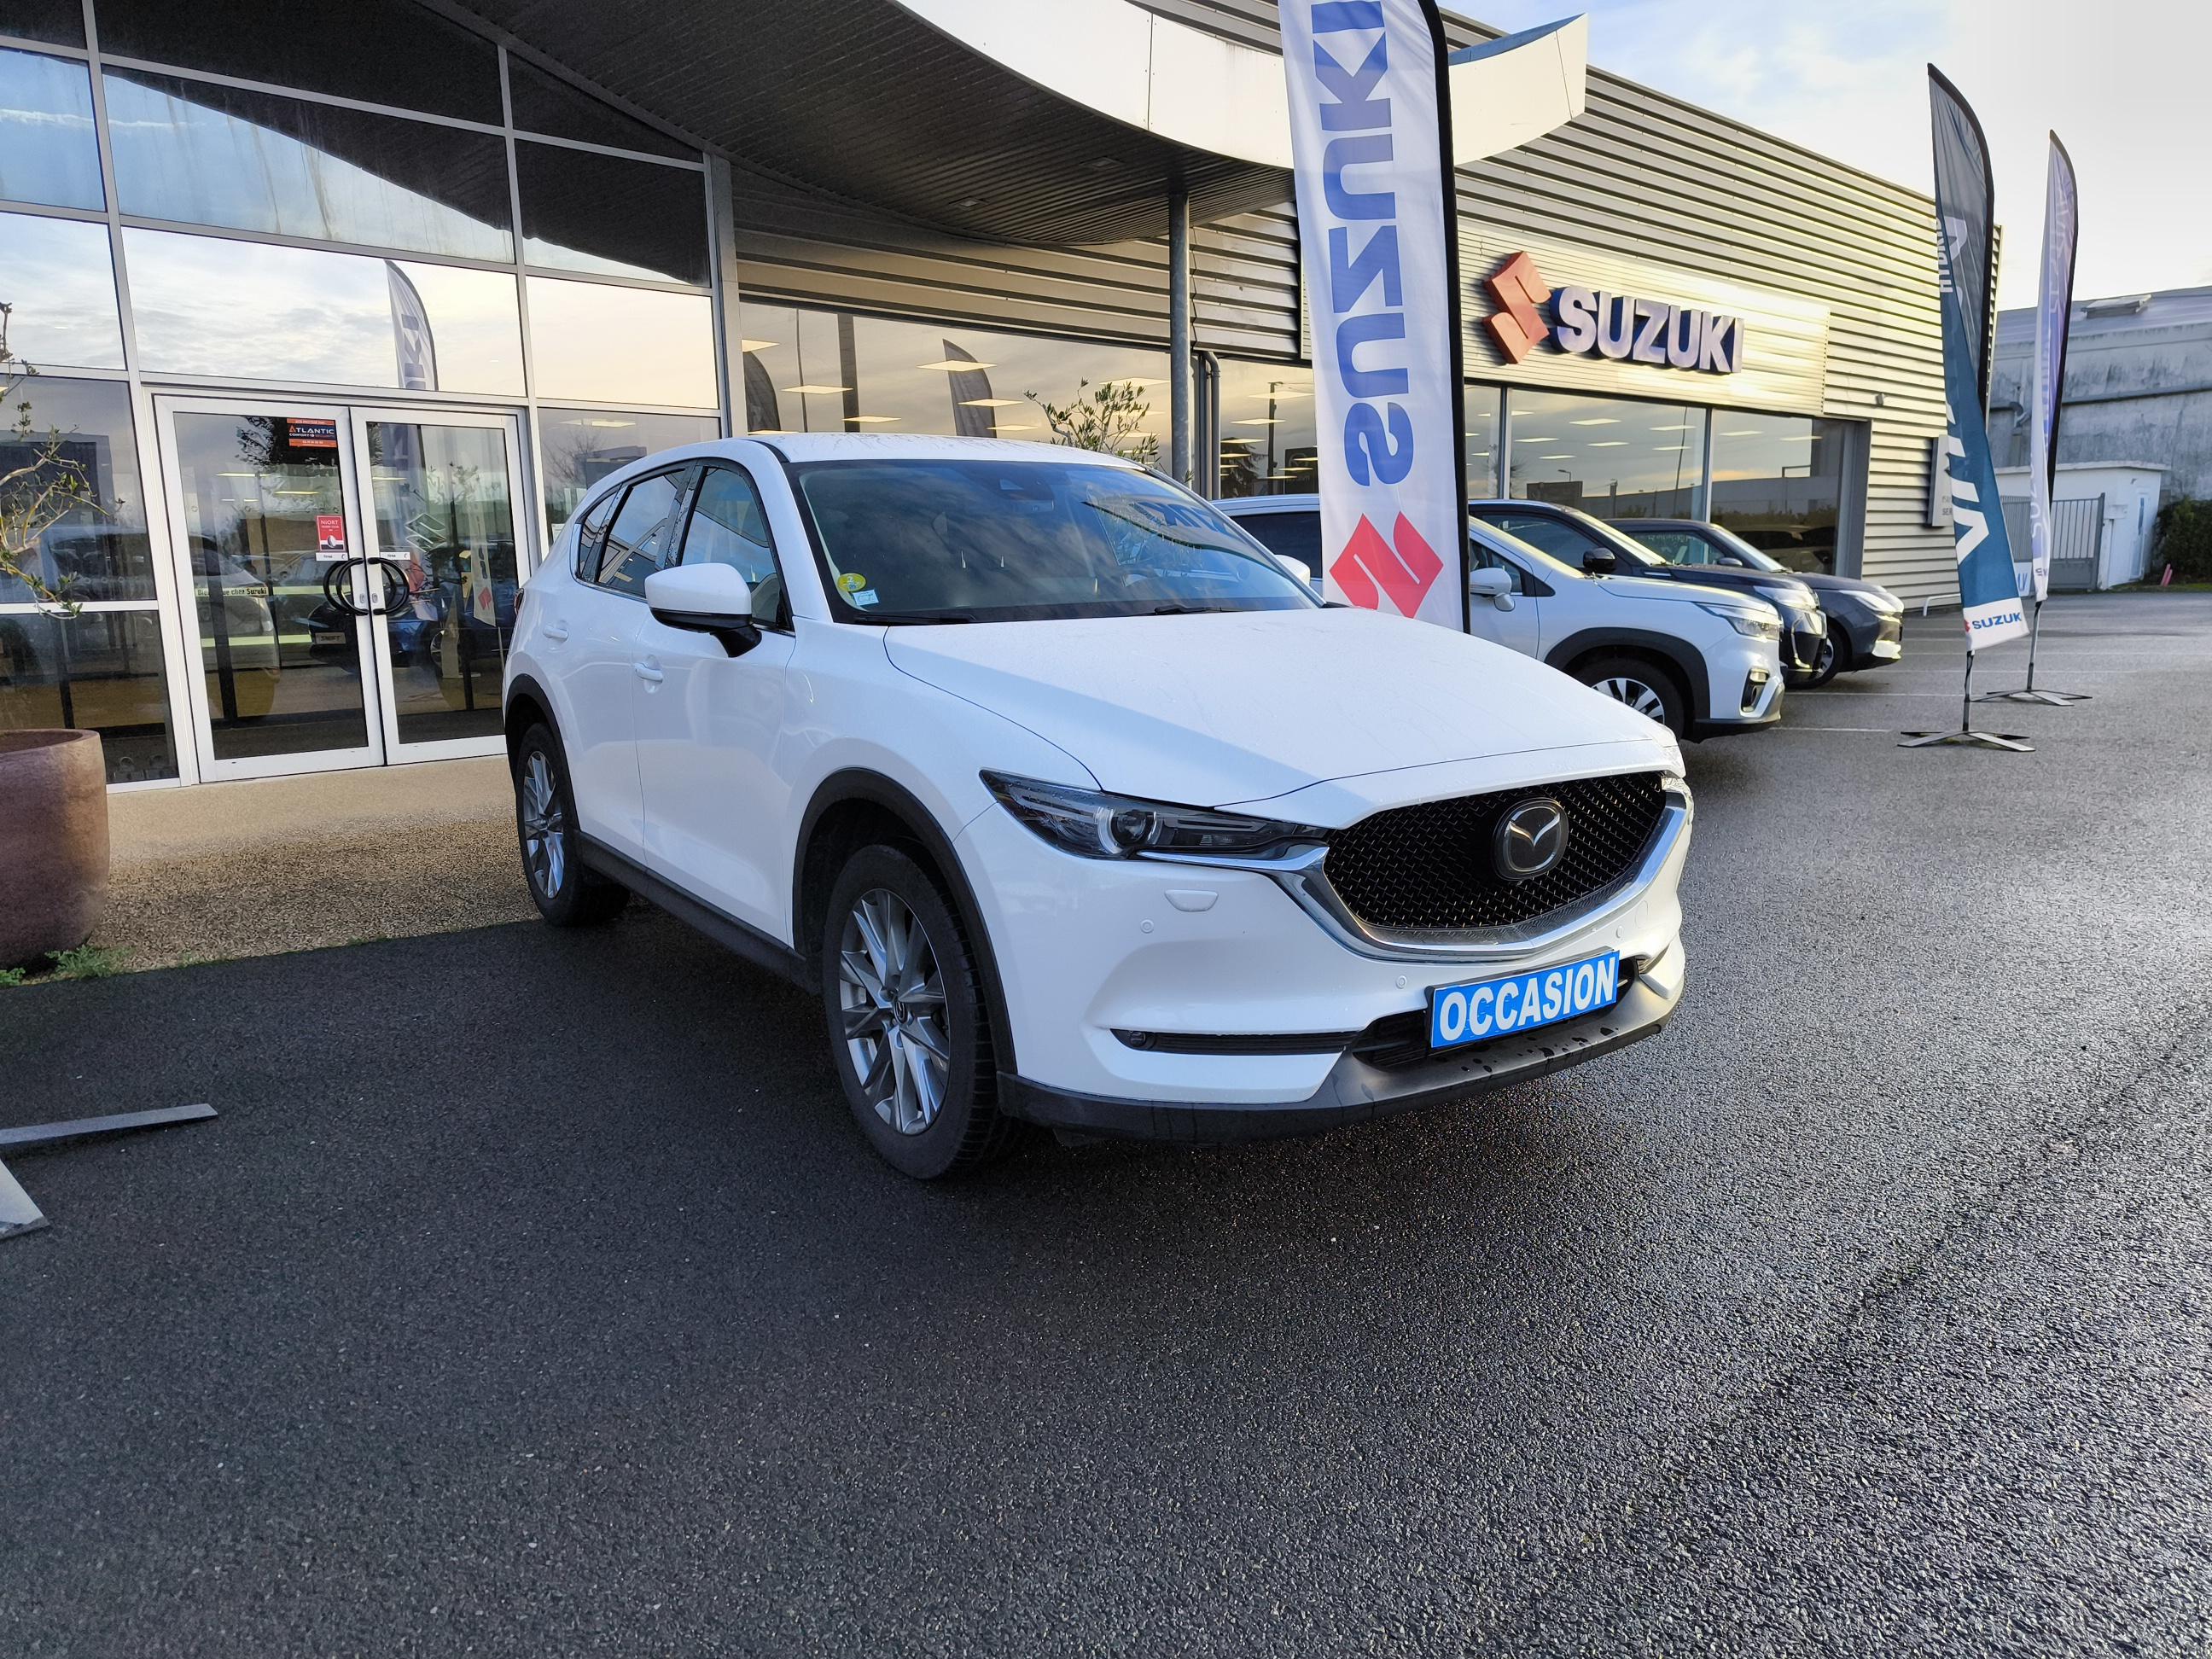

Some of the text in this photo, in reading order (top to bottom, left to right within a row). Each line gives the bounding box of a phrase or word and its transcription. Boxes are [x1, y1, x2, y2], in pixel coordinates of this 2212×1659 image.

[1552, 285, 1745, 374] SUZUKI
[288, 424, 335, 434] ATLANTIC
[1440, 957, 1615, 1041] OCCASION
